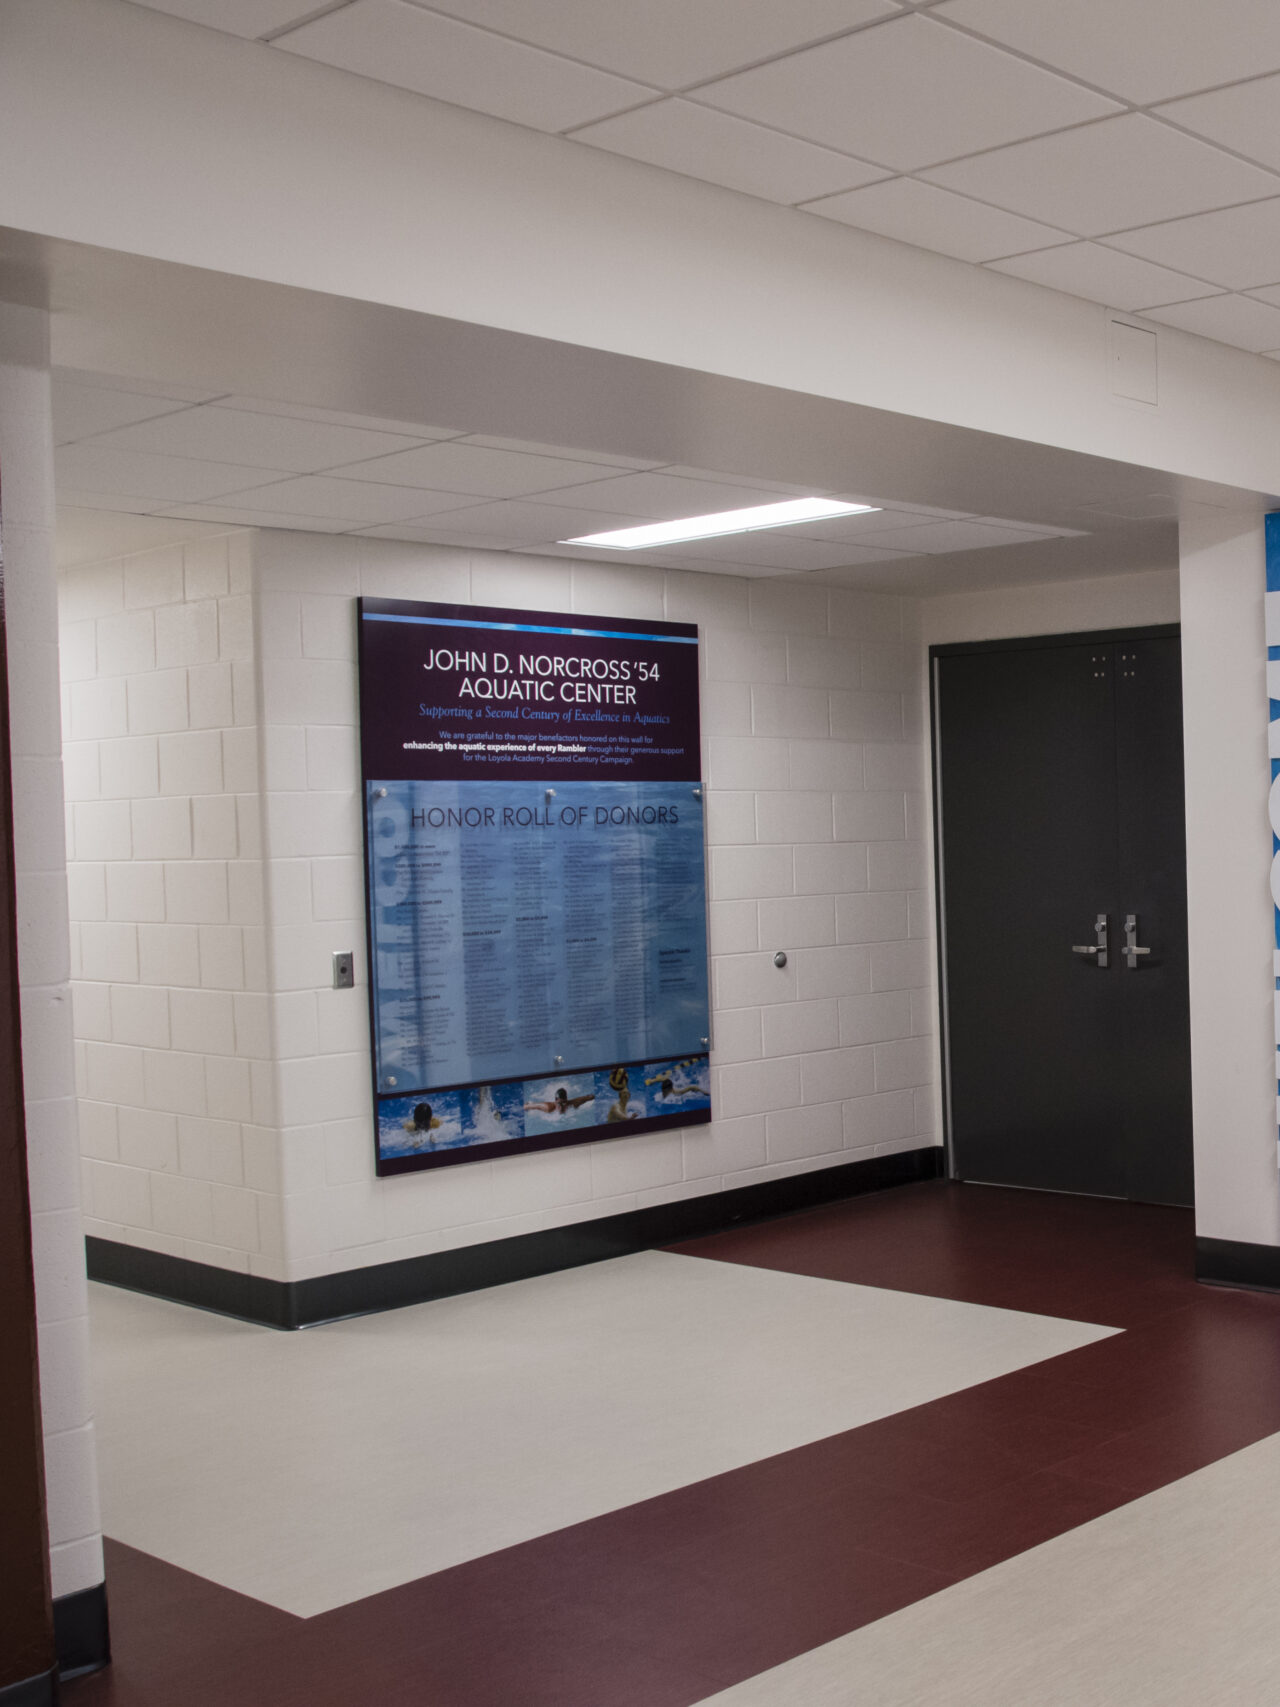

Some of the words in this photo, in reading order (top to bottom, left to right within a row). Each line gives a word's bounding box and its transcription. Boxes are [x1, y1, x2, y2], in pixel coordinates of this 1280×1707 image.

[423, 649, 487, 672] JOHN
[493, 653, 513, 674] D.
[519, 654, 631, 680] NORCROSS
[458, 677, 555, 702] AQUATIC
[560, 682, 637, 705] CENTER
[418, 703, 473, 721] Supporting
[475, 709, 482, 719] a
[485, 706, 520, 720] Second
[521, 707, 560, 723] Century
[562, 708, 573, 723] of
[574, 709, 620, 723] Excellence
[622, 711, 631, 723] in
[633, 713, 671, 726] Aquatics
[403, 741, 444, 752] enhancing
[445, 741, 458, 751] the
[458, 742, 486, 753] aquatic
[487, 743, 527, 753] experience
[527, 743, 536, 752] of
[537, 744, 556, 754] every
[557, 744, 586, 753] Rambler
[587, 745, 613, 755] through
[614, 745, 629, 754] their
[630, 747, 660, 756] generous
[660, 747, 685, 756] support
[439, 730, 452, 739] We
[453, 732, 465, 740] are
[466, 731, 495, 742] grateful
[495, 732, 503, 740] to
[504, 731, 516, 741] the
[517, 732, 537, 743] major
[538, 732, 578, 742] benefactors
[579, 734, 607, 743] honored
[618, 735, 631, 744] this
[631, 735, 643, 744] wall
[644, 735, 654, 744] for
[463, 752, 474, 762] for
[475, 753, 487, 762] the
[488, 754, 511, 763] Loyola
[512, 754, 545, 764] Academy
[546, 754, 571, 763] Second
[572, 755, 599, 765] Century
[411, 806, 496, 828] HONOR
[503, 805, 555, 827] ROLL
[560, 805, 588, 826] OF
[595, 805, 679, 825] DONORS
